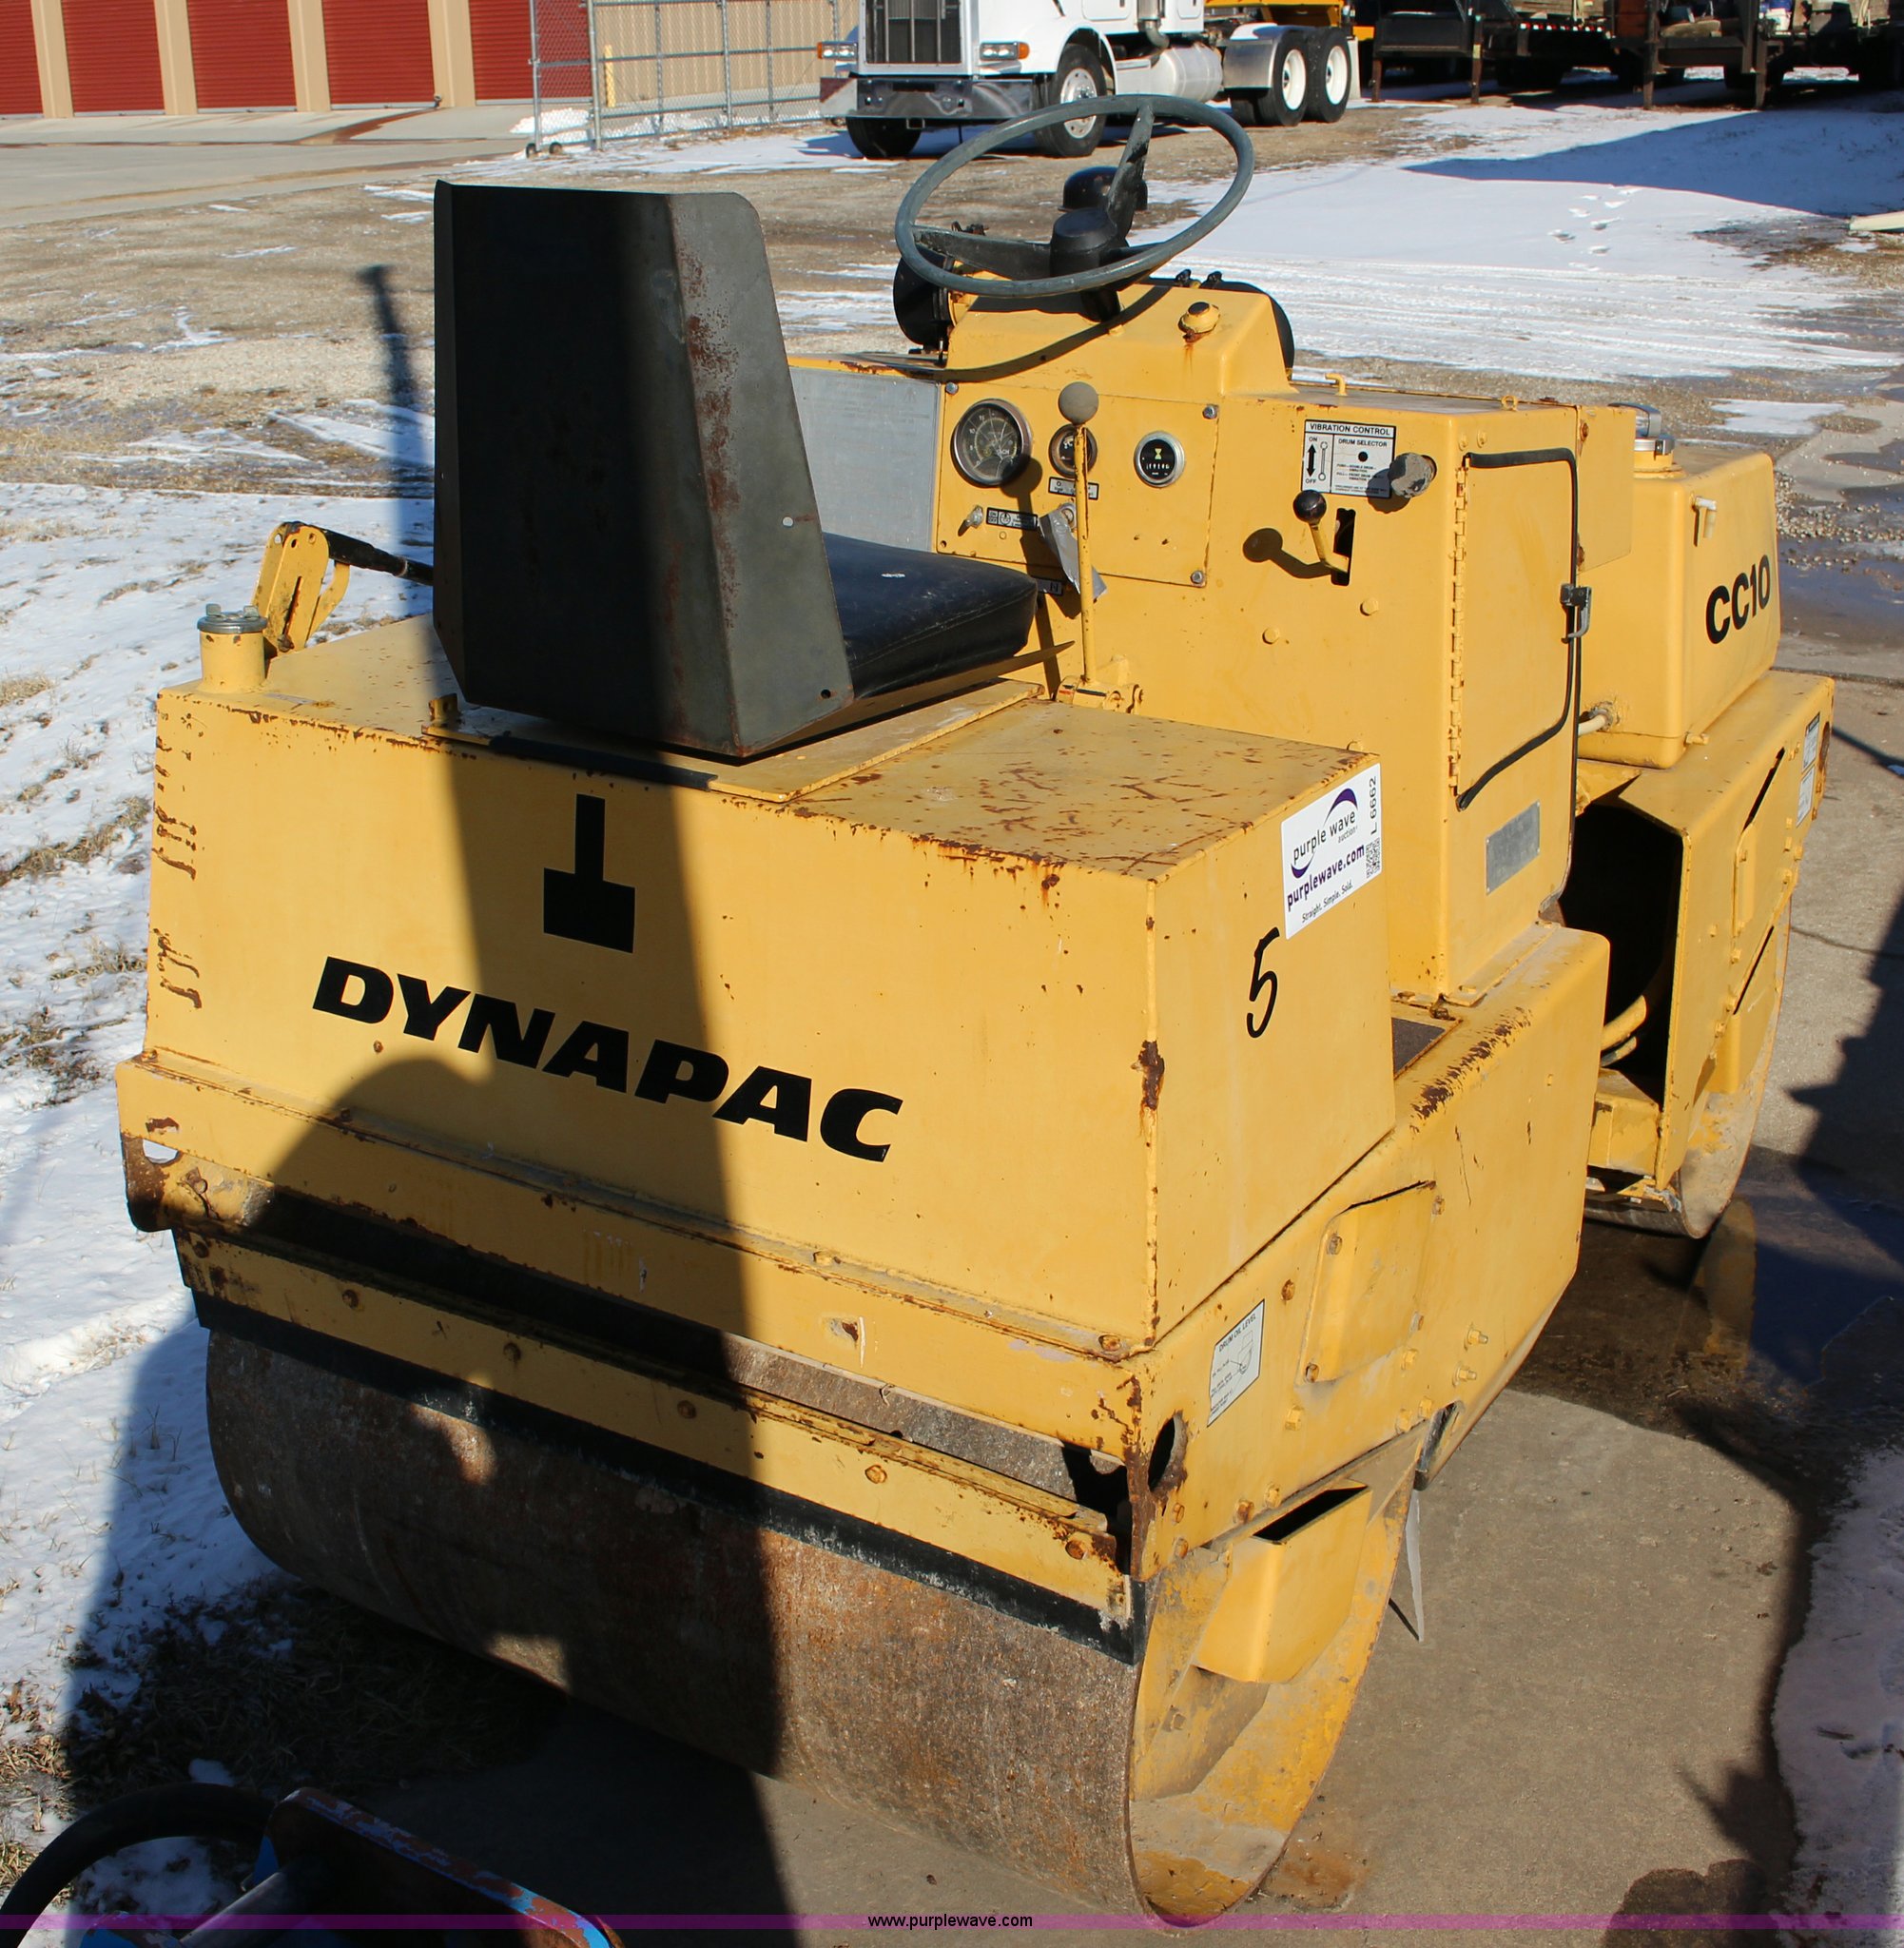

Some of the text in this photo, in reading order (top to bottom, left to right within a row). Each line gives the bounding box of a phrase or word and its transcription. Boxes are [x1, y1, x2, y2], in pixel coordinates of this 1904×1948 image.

[1310, 423, 1390, 436] VIBRATION CONTROL
[1705, 554, 1771, 645] CC10
[1369, 775, 1377, 820] 6662
[1292, 810, 1356, 865] purple wave
[1286, 844, 1365, 912] purplewave.com
[1301, 880, 1353, 924] Straight. Simple. Sold.
[1246, 926, 1280, 1039] 5
[312, 955, 903, 1163] DYNAPAC
[1218, 1334, 1234, 1353] DRUM
[1242, 1313, 1256, 1330] LEVEL
